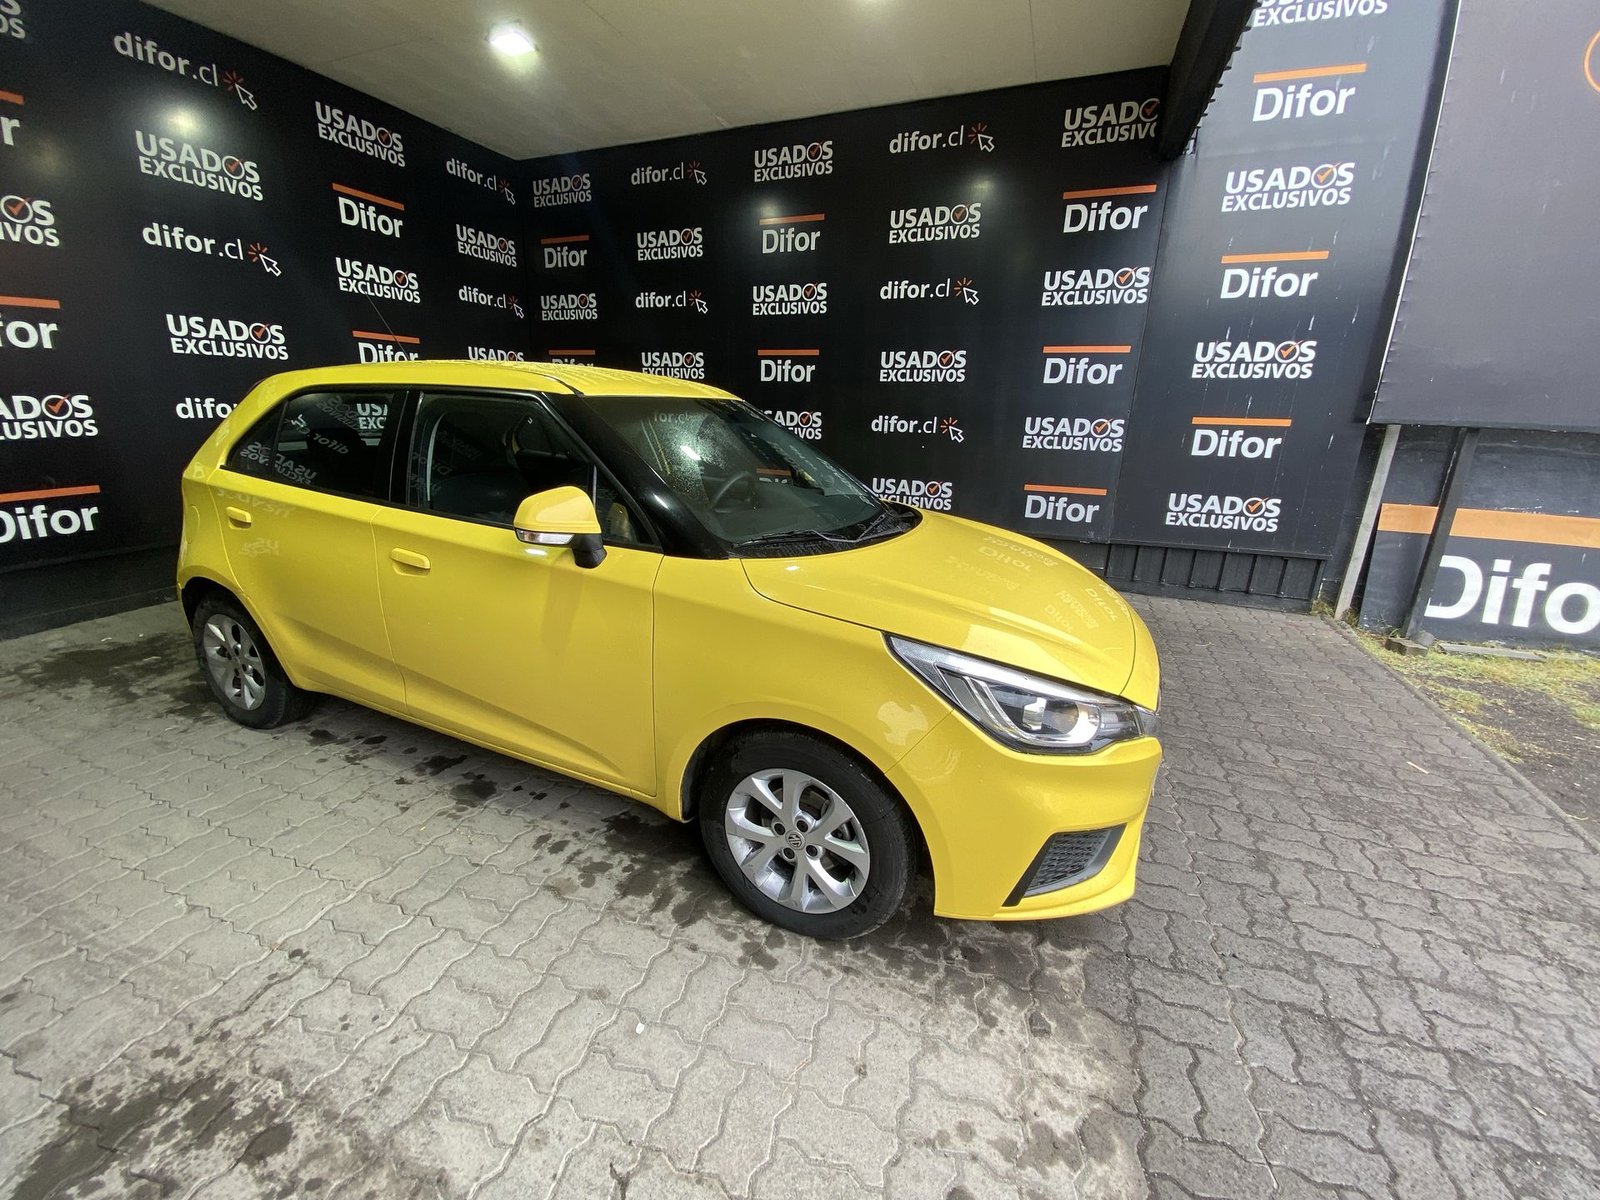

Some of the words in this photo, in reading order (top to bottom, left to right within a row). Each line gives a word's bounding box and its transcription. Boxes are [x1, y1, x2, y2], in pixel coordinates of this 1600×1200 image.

[1253, 0, 1388, 28] EXCLUSIVOS
[114, 32, 218, 86] difor.cl
[1252, 83, 1356, 122] Difor
[315, 101, 404, 152] USADOS
[317, 123, 406, 168] EXCLUSIVOS
[889, 125, 964, 154] difor.cl
[135, 130, 260, 184] USADOS
[754, 140, 833, 168] USADOS
[139, 156, 263, 201] EXCLUSIVOS
[446, 158, 497, 191] difor.cl
[631, 162, 684, 186] difor.cl
[754, 160, 833, 183] EXCLUSIVOS
[1225, 162, 1355, 194] USADOS
[533, 173, 591, 196] USADOS
[533, 191, 592, 208] EXCLUSIVOS
[1221, 187, 1351, 212] EXCLUSIVOS
[338, 196, 403, 238] Difor
[889, 202, 982, 229] USADOS
[1063, 200, 1148, 233] Difor
[142, 222, 244, 261] difor.cl
[456, 223, 516, 255] USADOS
[636, 227, 703, 249] USADOS
[762, 227, 821, 254] Difor
[888, 223, 980, 244] EXCLUSIVOS
[457, 241, 517, 268] EXCLUSIVOS
[544, 247, 588, 269] Difor
[637, 244, 703, 261] EXCLUSIVOS
[335, 257, 419, 290] USADOS
[1043, 266, 1150, 290] USADOS
[1220, 266, 1318, 299] Difor
[338, 276, 421, 304] EXCLUSIVOS
[458, 285, 506, 309] difor.cl
[635, 290, 686, 309] difor.cl
[752, 282, 828, 303] USADOS
[879, 278, 950, 300] difor.cl
[1041, 288, 1148, 307] EXCLUSIVOS
[540, 293, 597, 310] USADOS
[752, 301, 828, 316] EXCLUSIVOS
[541, 309, 598, 321] EXCLUSIVOS
[166, 313, 286, 345] USADOS
[170, 337, 289, 360] EXCLUSIVOS
[641, 352, 705, 368] USADOS
[880, 349, 967, 369] USADOS
[1194, 340, 1317, 363] USADOS
[760, 359, 816, 383] Difor
[879, 368, 966, 383] EXCLUSIVOS
[1043, 356, 1123, 385] Difor
[1191, 363, 1313, 379] EXCLUSIVOS
[871, 414, 937, 435] difor.cl
[1024, 416, 1125, 439] USADOS
[1022, 434, 1123, 453] EXCLUSIVOS
[1191, 429, 1282, 459] Difor
[872, 477, 953, 498] USADOS
[1024, 494, 1100, 523] Difor
[1168, 493, 1281, 518] USADOS
[1165, 511, 1278, 532] EXCLUSIVOS
